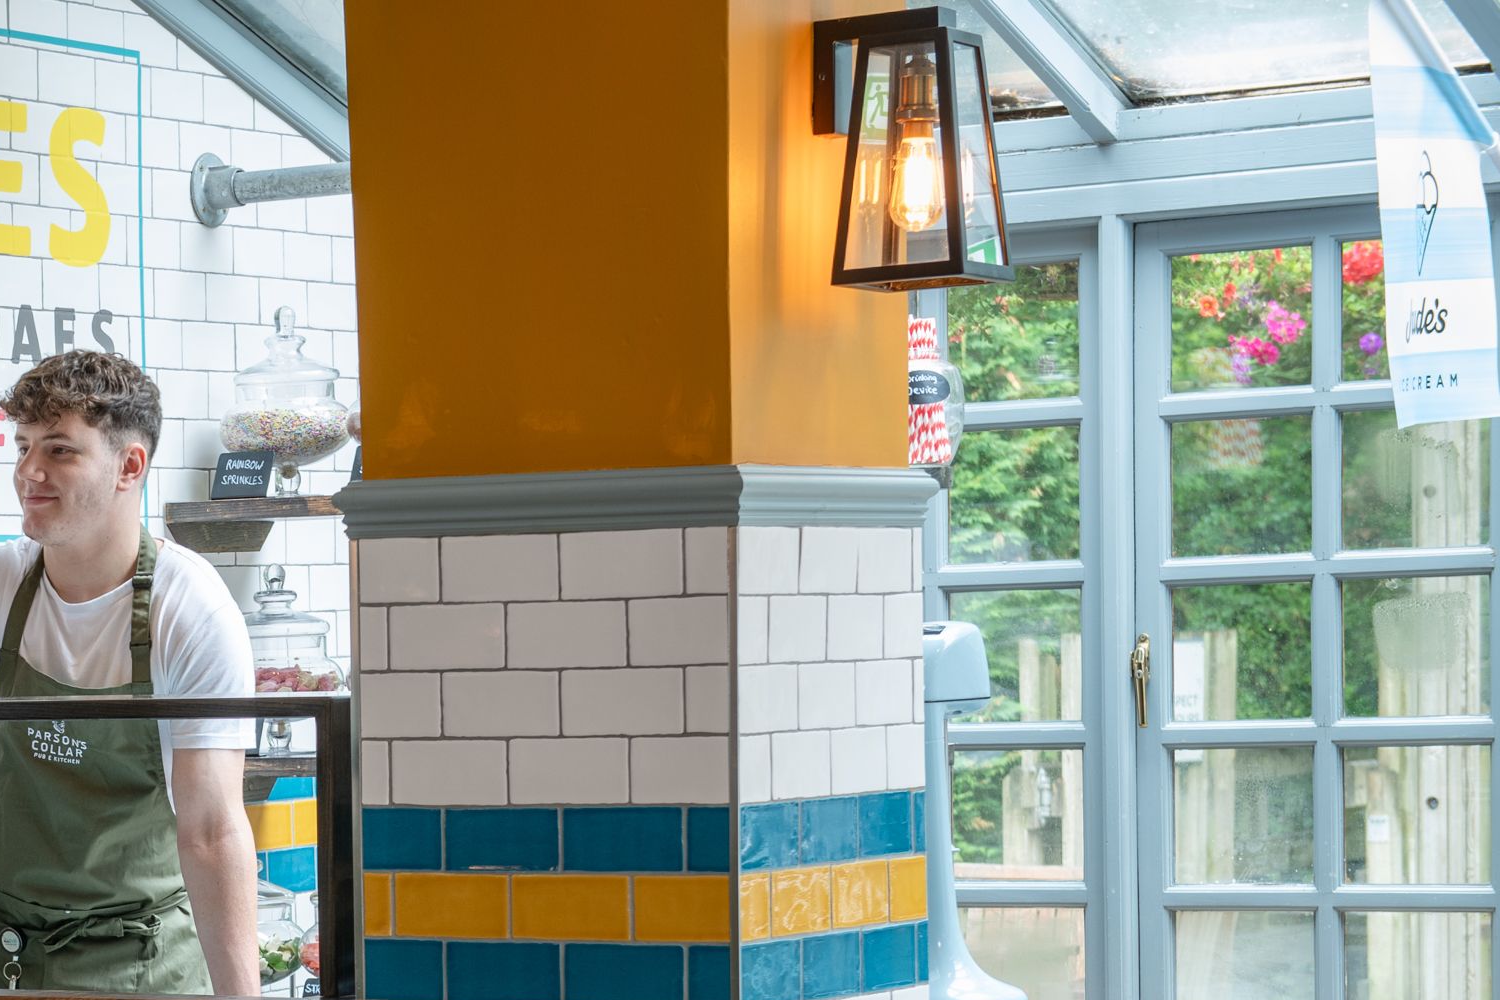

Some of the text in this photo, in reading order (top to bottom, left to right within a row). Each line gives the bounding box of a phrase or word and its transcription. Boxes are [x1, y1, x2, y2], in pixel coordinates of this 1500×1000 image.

[225, 458, 265, 470] RAINBOW
[221, 474, 263, 485] SPRINKLES
[28, 727, 87, 750] PARSON'S
[31, 740, 83, 758] COLLAR
[33, 752, 46, 760] PUB
[53, 756, 80, 764] KITCHEN
[304, 983, 320, 994] STR
